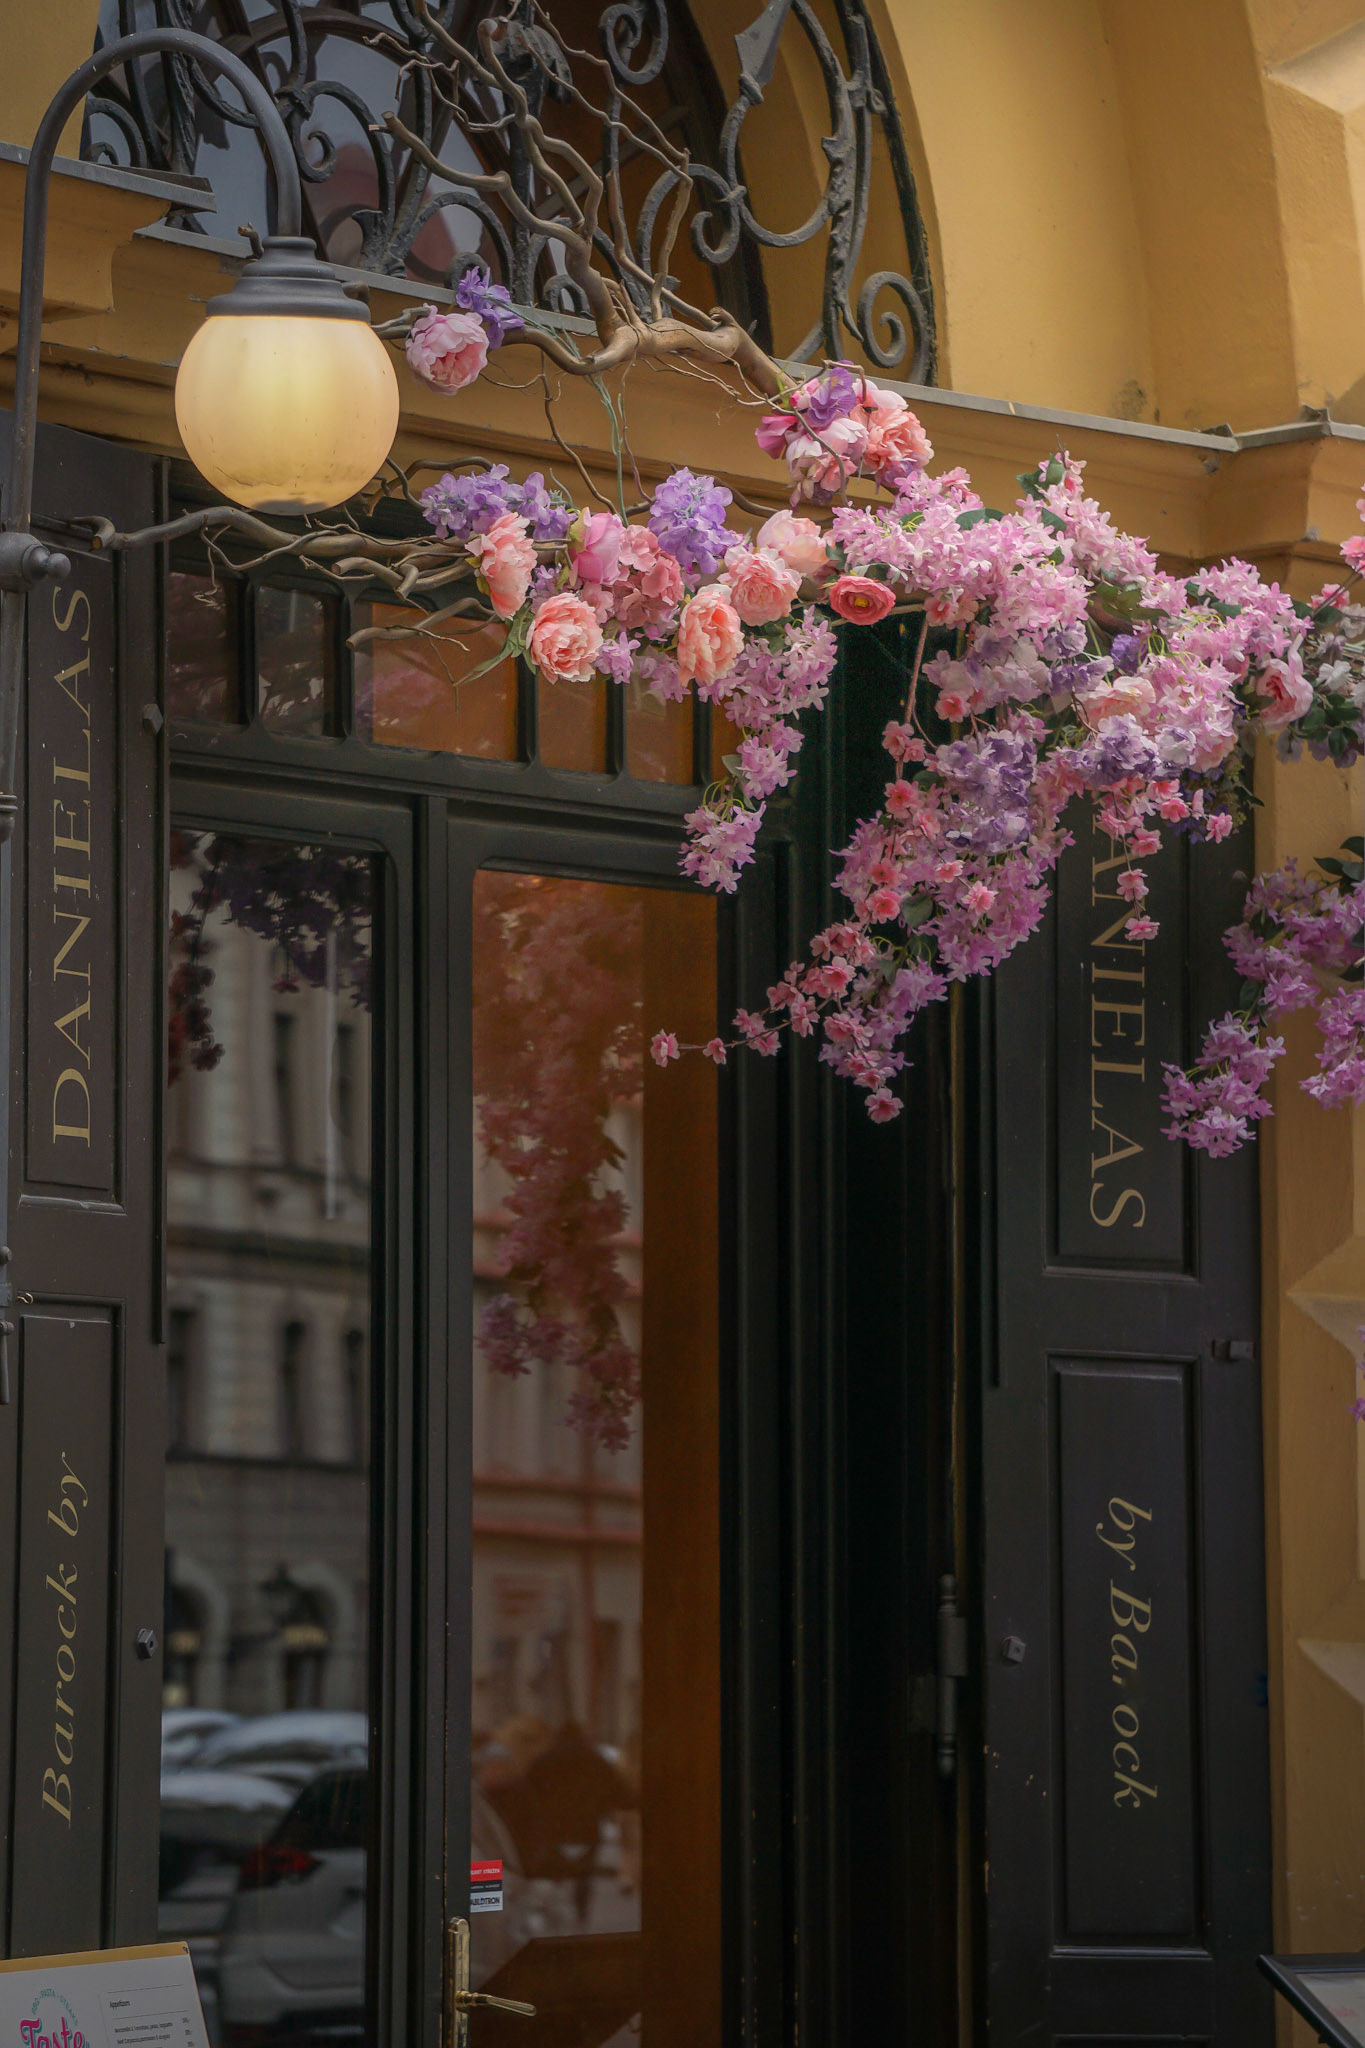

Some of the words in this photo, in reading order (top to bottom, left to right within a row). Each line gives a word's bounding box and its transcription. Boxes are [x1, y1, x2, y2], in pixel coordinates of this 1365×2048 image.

[53, 586, 91, 1148] DANIELAS
[1090, 811, 1146, 1228] ANIELAS
[47, 1451, 88, 1537] by
[1096, 1497, 1152, 1571] by
[42, 1563, 79, 1829] Barock
[1110, 1579, 1158, 1808] Baock
[471, 1897, 500, 1905] ABLOTRON
